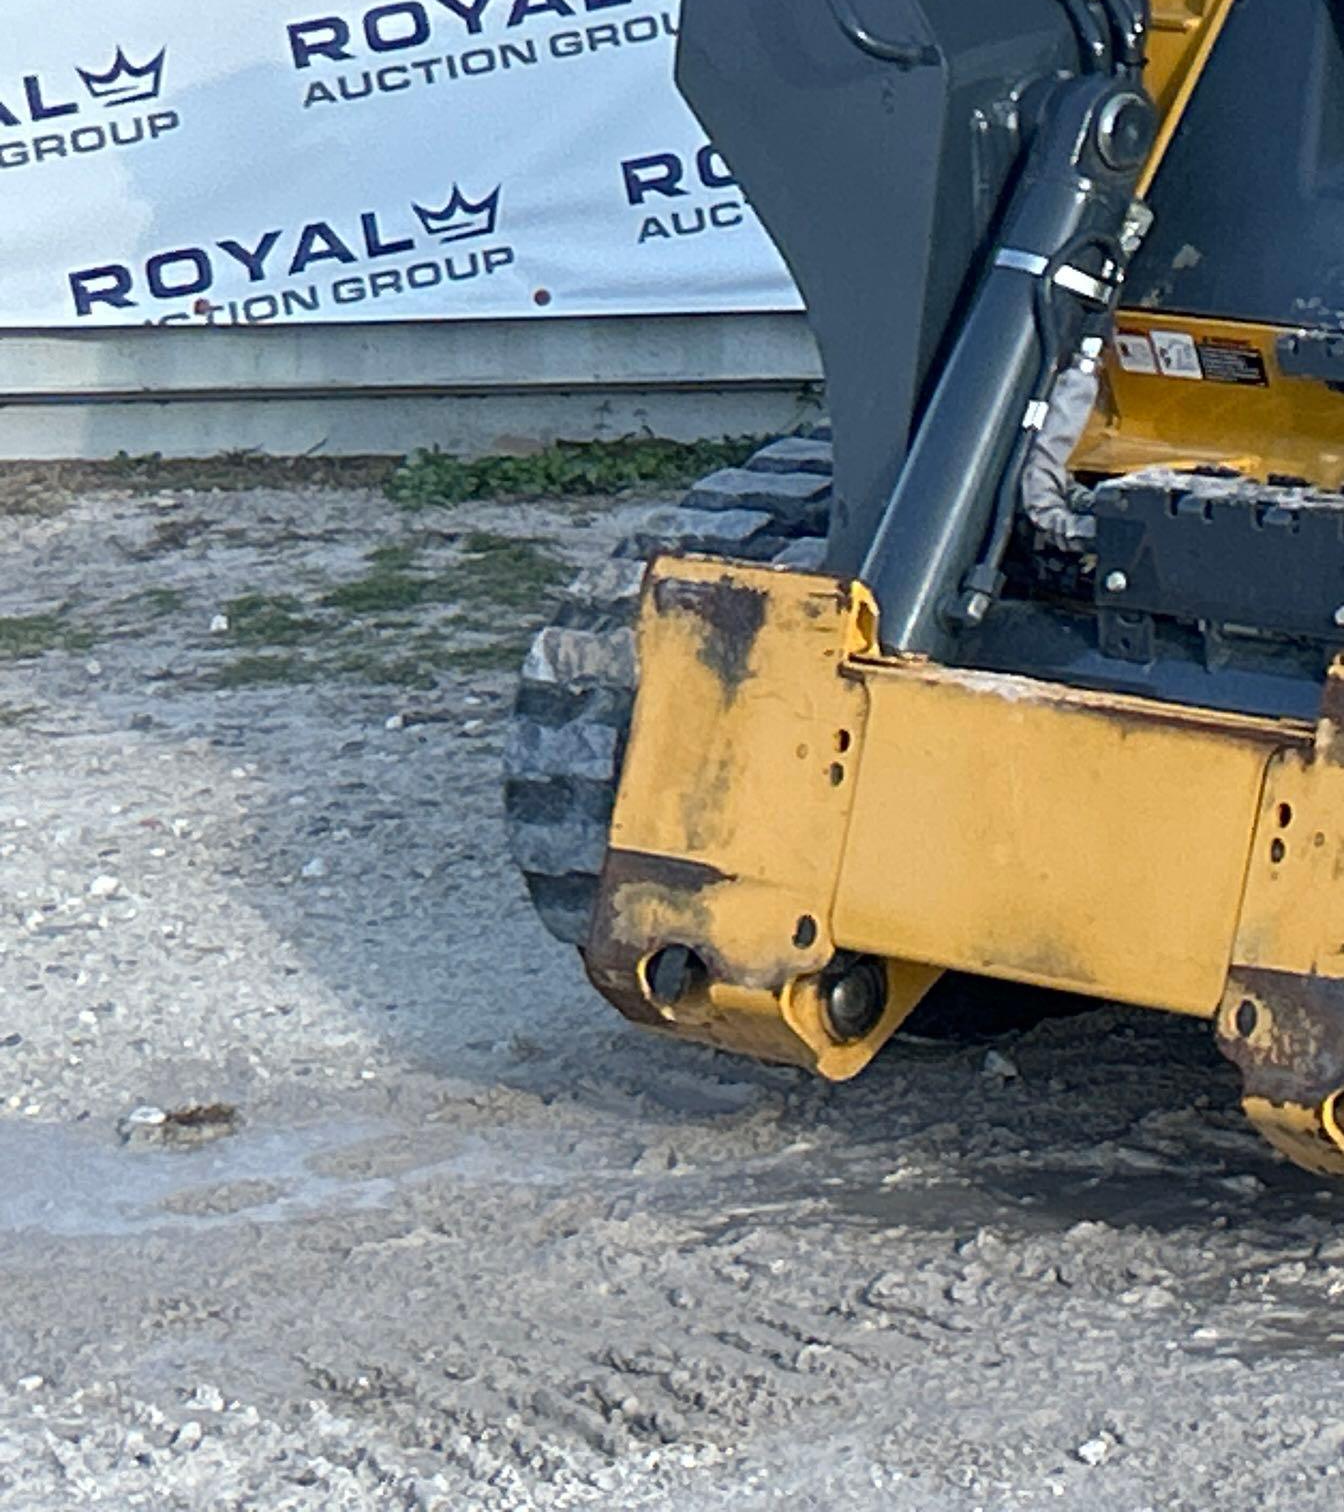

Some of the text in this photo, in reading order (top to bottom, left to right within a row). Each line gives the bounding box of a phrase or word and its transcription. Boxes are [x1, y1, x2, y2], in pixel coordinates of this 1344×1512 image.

[304, 8, 681, 109] AUCTION GRO
[0, 110, 181, 170] GROUP
[68, 211, 417, 318] ROYAL
[329, 246, 515, 305] GROUP
